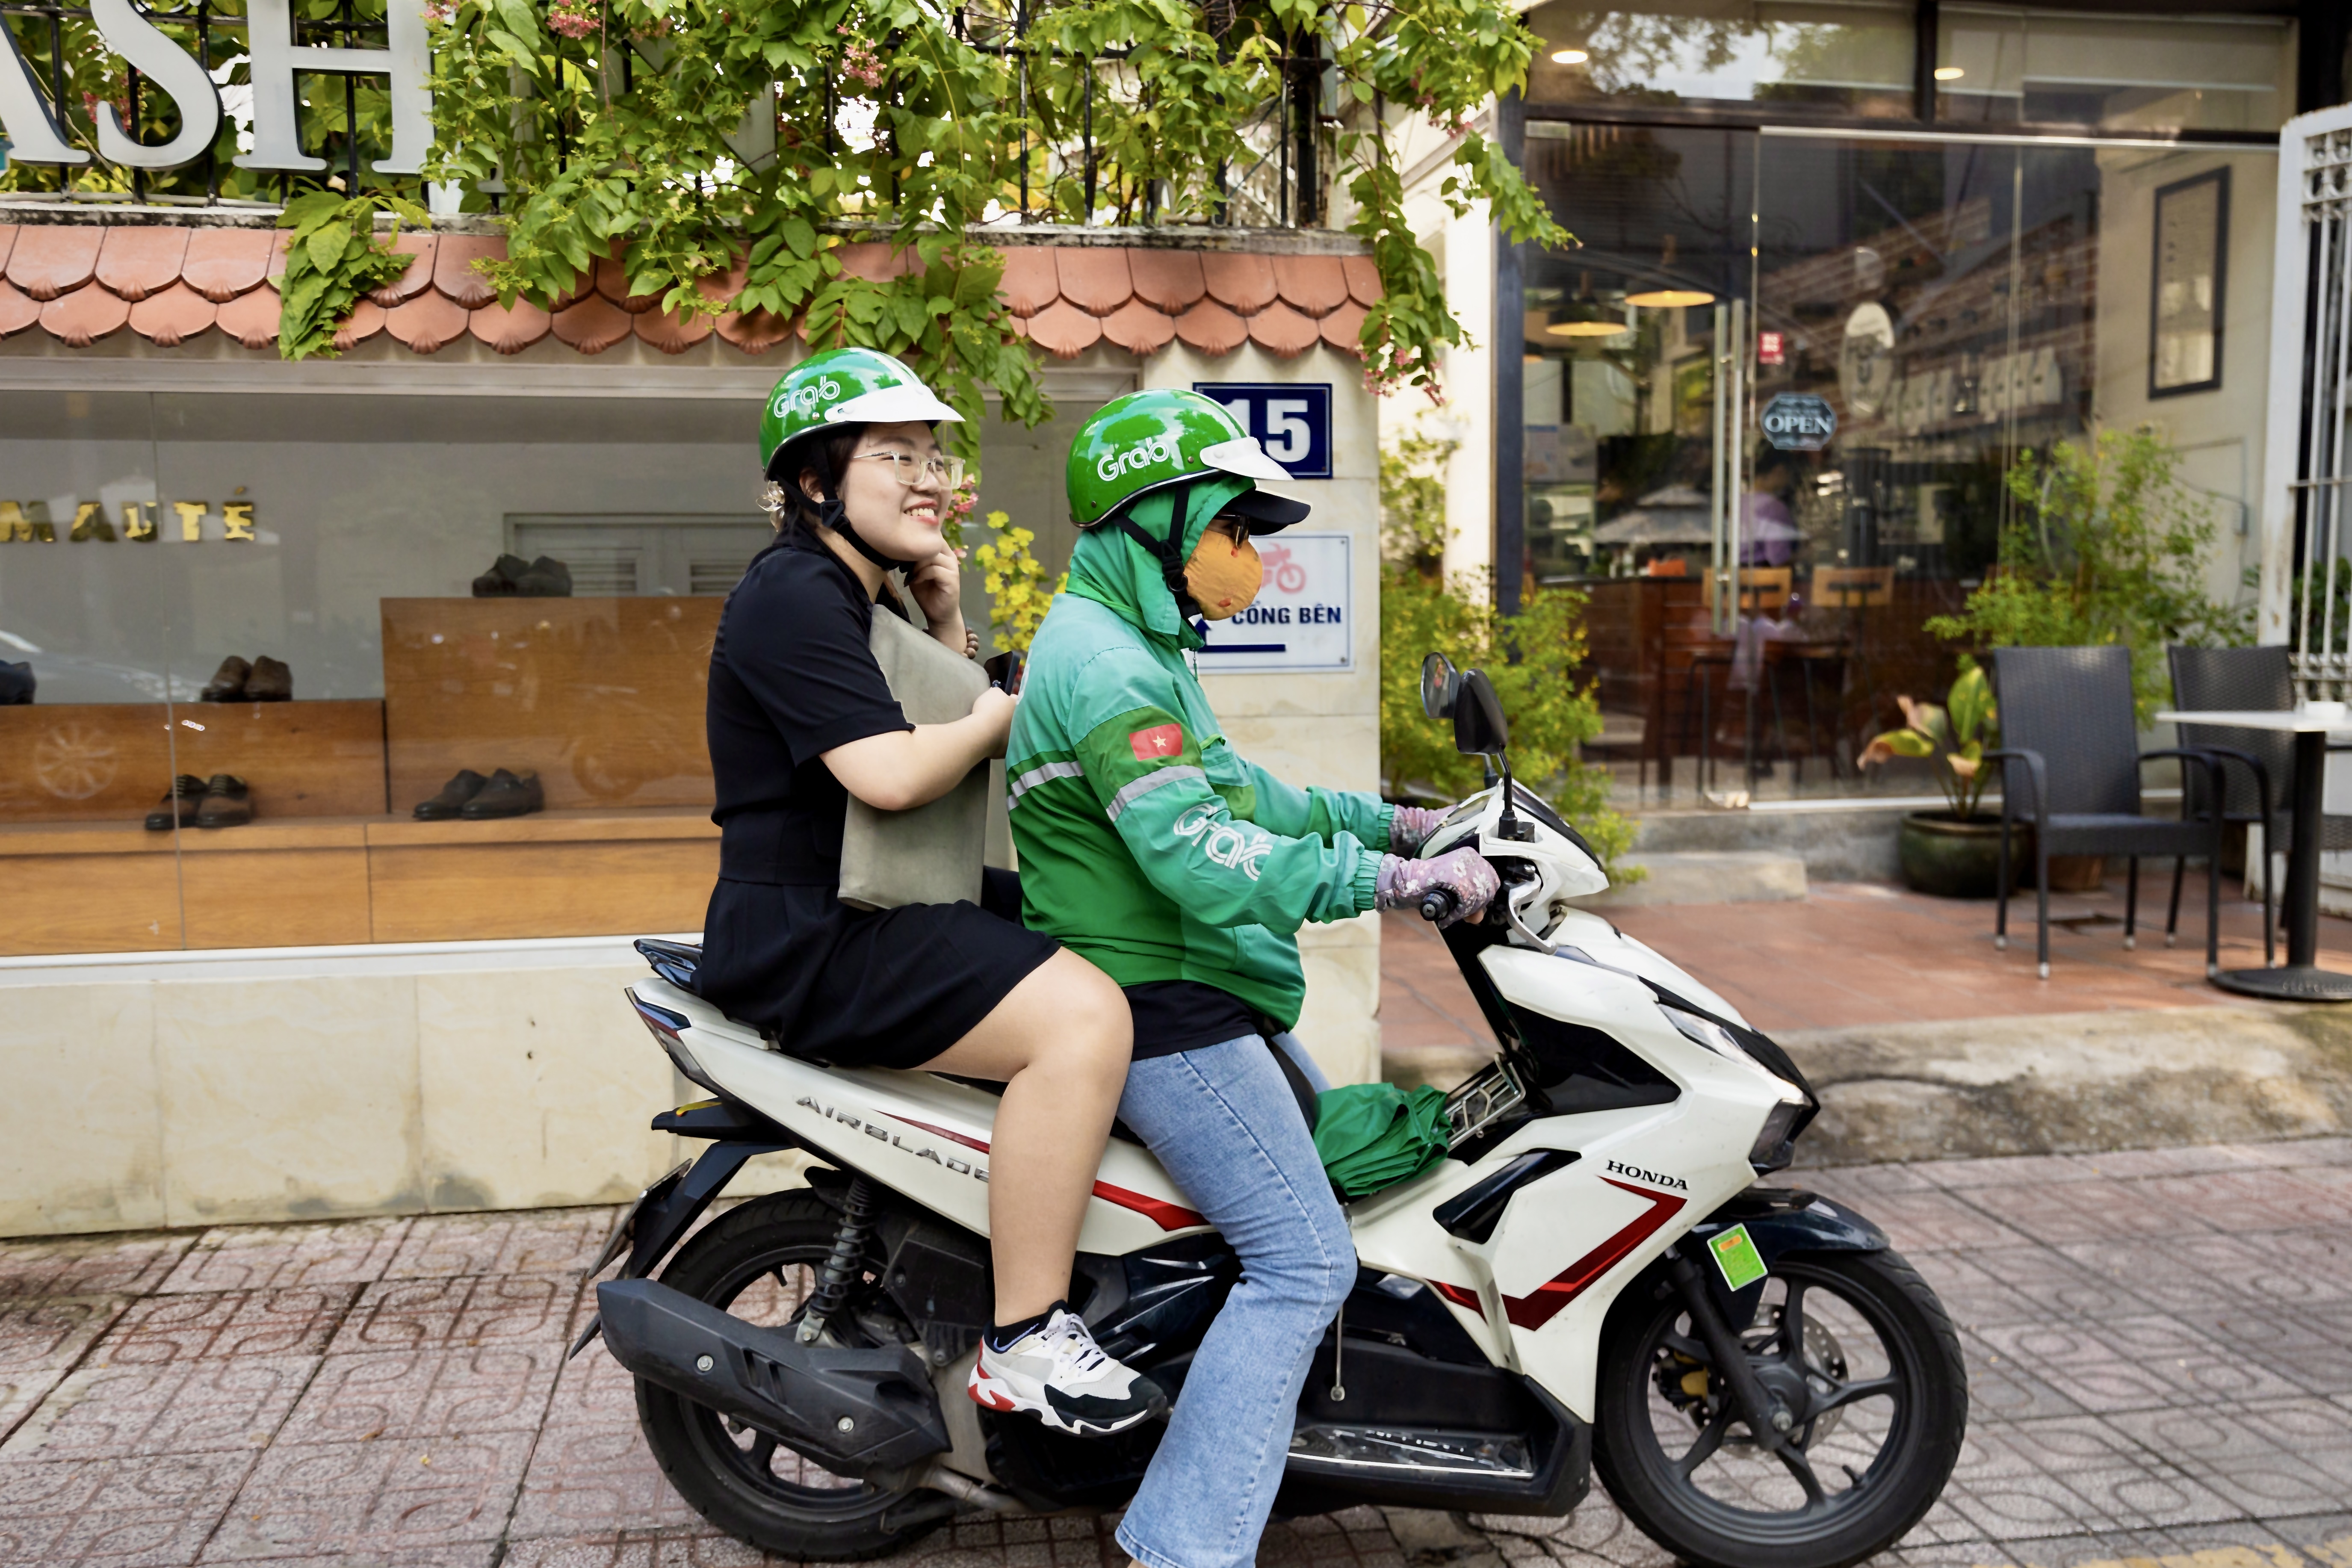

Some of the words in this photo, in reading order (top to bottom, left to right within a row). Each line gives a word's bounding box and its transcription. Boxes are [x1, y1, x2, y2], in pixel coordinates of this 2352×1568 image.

[774, 376, 840, 418] Grab
[1764, 413, 1832, 435] OPEN
[1097, 437, 1170, 481] Grab
[1300, 603, 1341, 623] BÊN
[1606, 1160, 1688, 1190] HONDA
